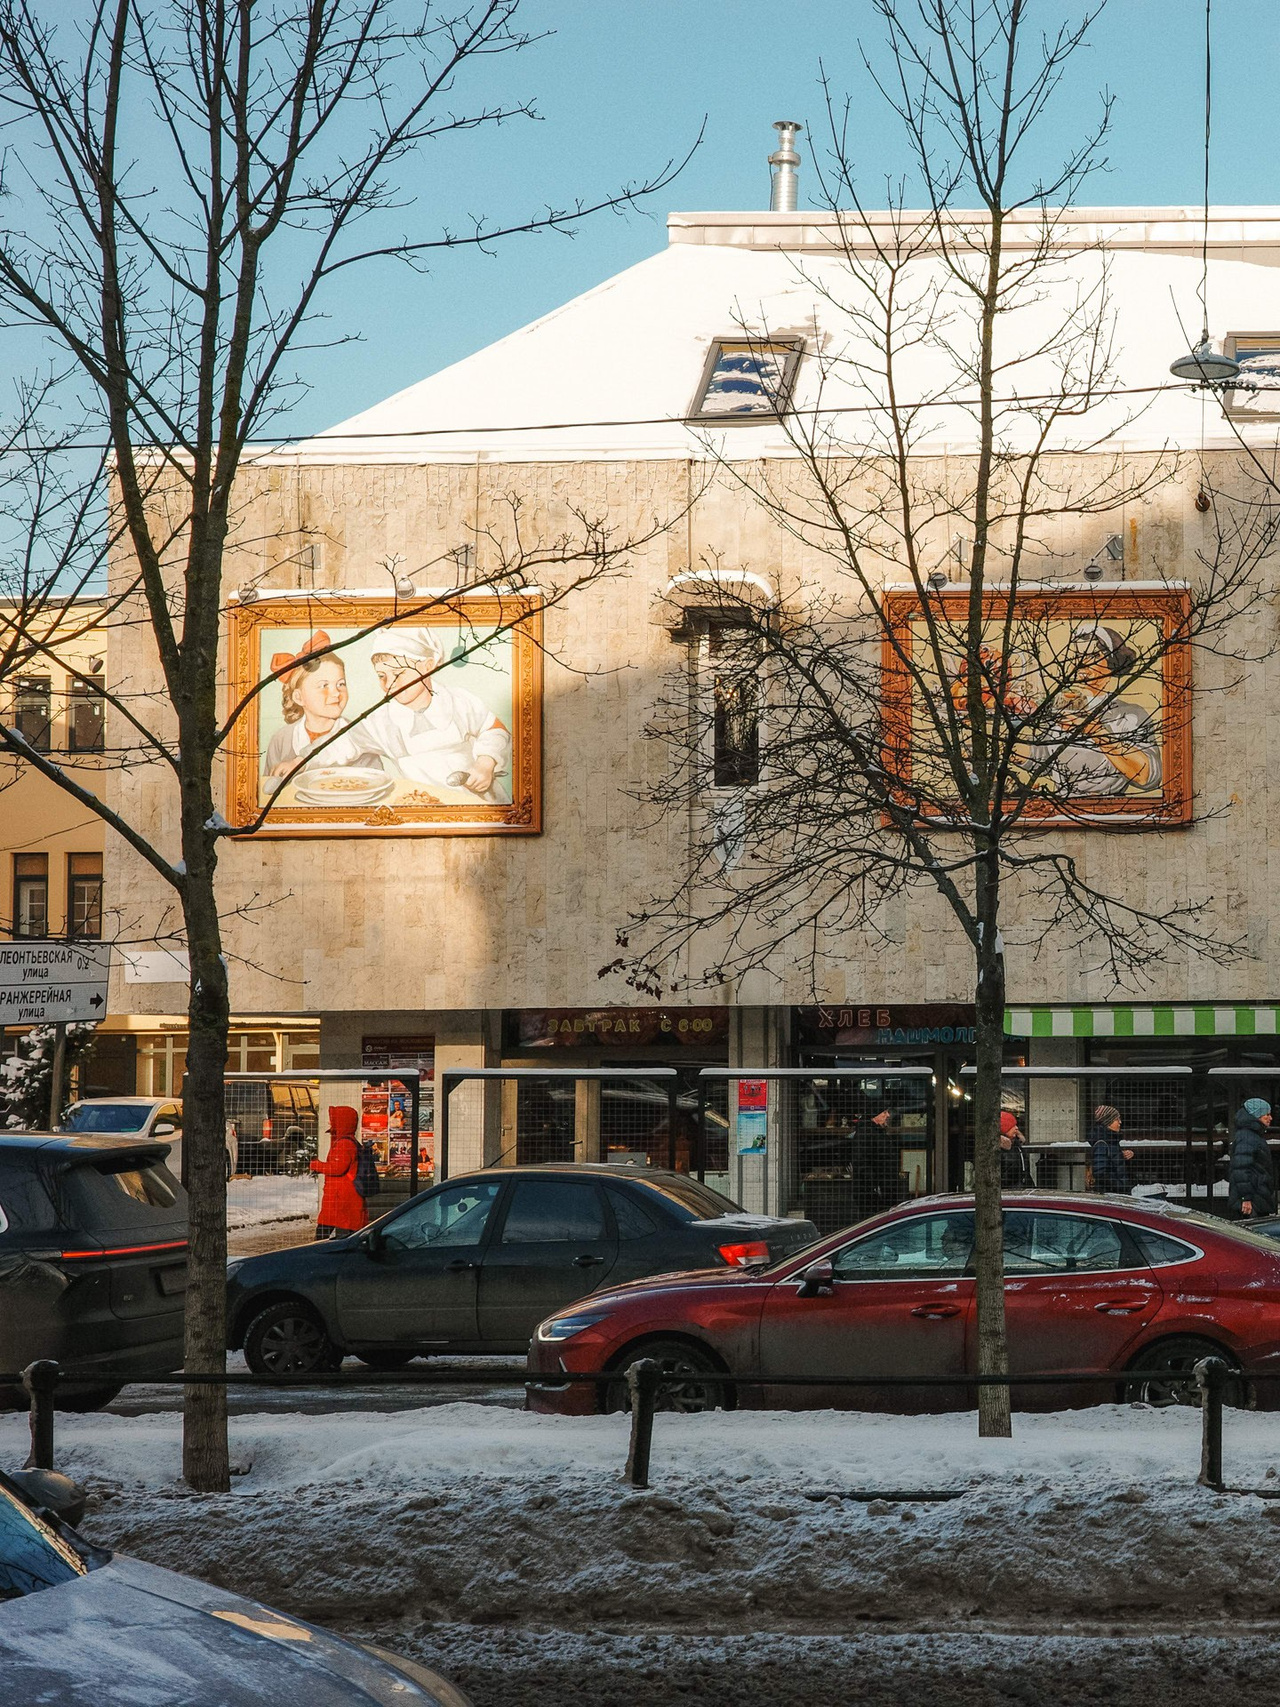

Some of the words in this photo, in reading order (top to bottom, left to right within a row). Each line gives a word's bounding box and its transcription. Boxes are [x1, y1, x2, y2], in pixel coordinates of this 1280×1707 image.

[0, 950, 73, 965] ЛЕОНТЬЕВСКАЯ
[22, 967, 49, 981] улица
[0, 986, 72, 1005] РАНЖЕРЕЙНАЯ
[18, 1007, 45, 1021] улица
[818, 1009, 891, 1028] ХЛЕБ
[548, 1018, 641, 1032] ЗАВТРАК
[678, 1018, 713, 1032] 6:00
